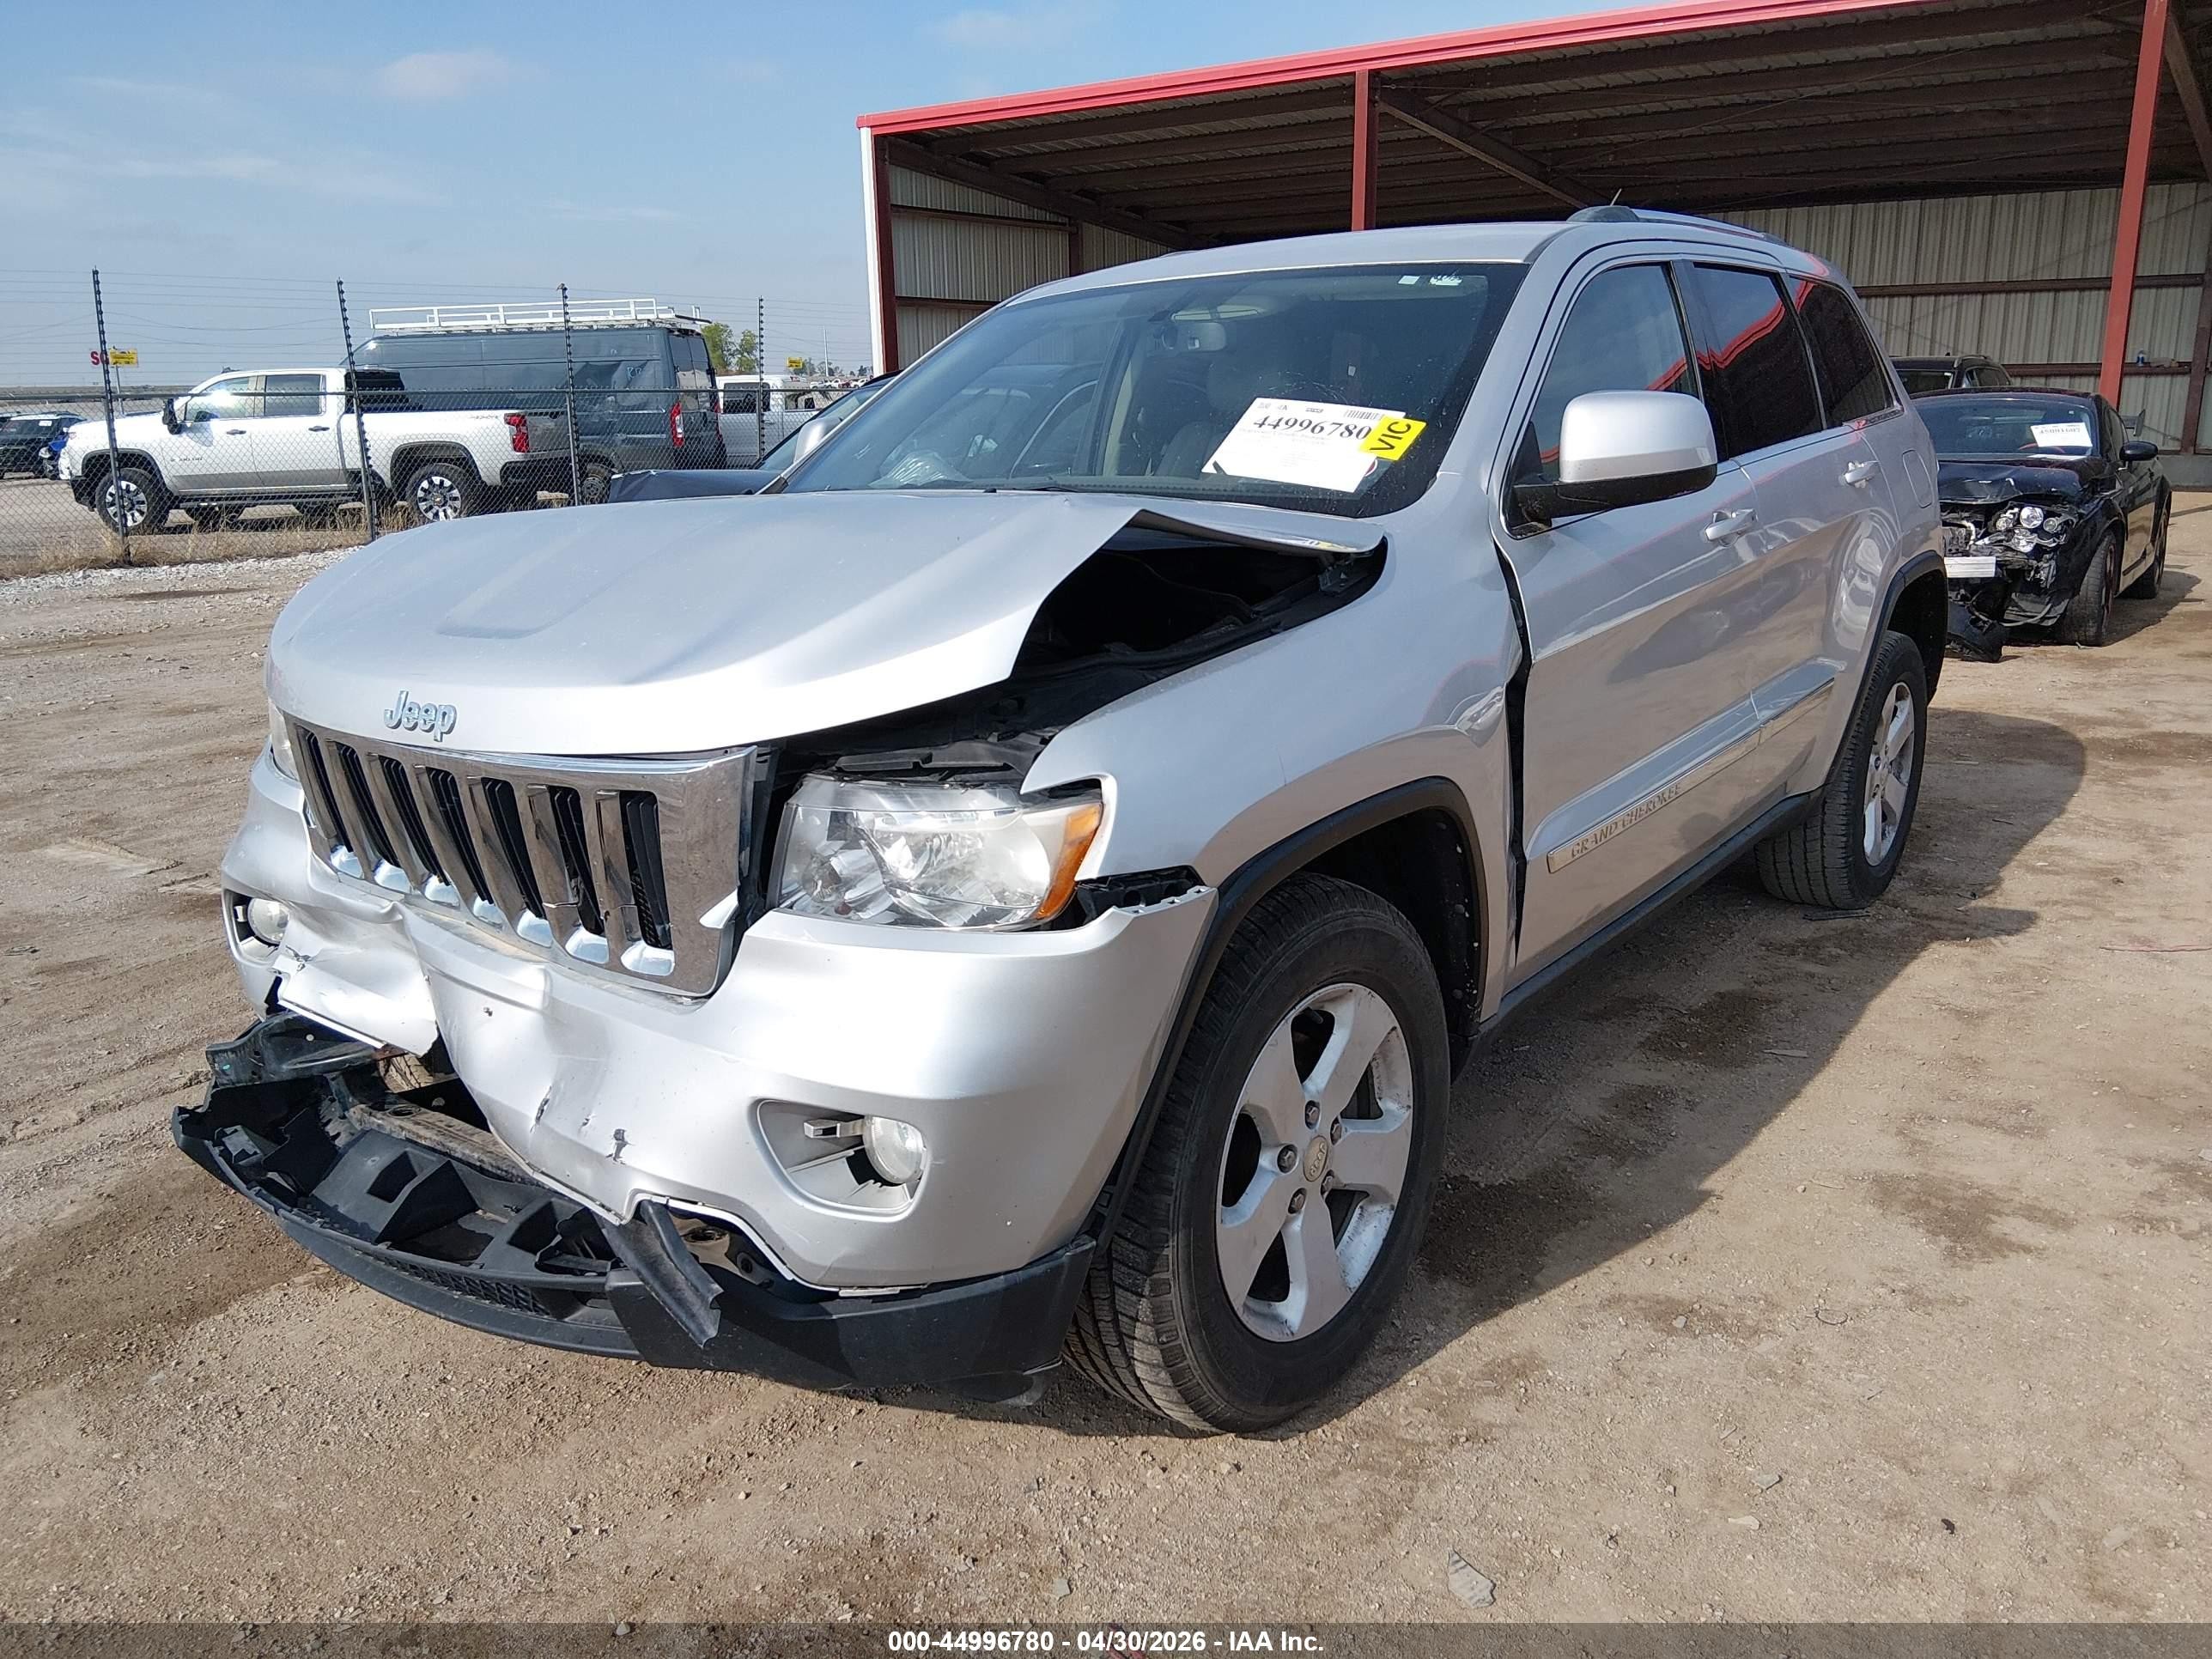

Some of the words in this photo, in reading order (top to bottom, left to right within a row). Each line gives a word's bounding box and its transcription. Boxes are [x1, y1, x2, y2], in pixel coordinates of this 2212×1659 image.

[1254, 415, 1372, 441] 44996780
[1369, 421, 1412, 451] VIC
[384, 690, 458, 743] Jeep
[1571, 822, 1618, 858] GRAND
[1622, 782, 1681, 828] CHEROKEE
